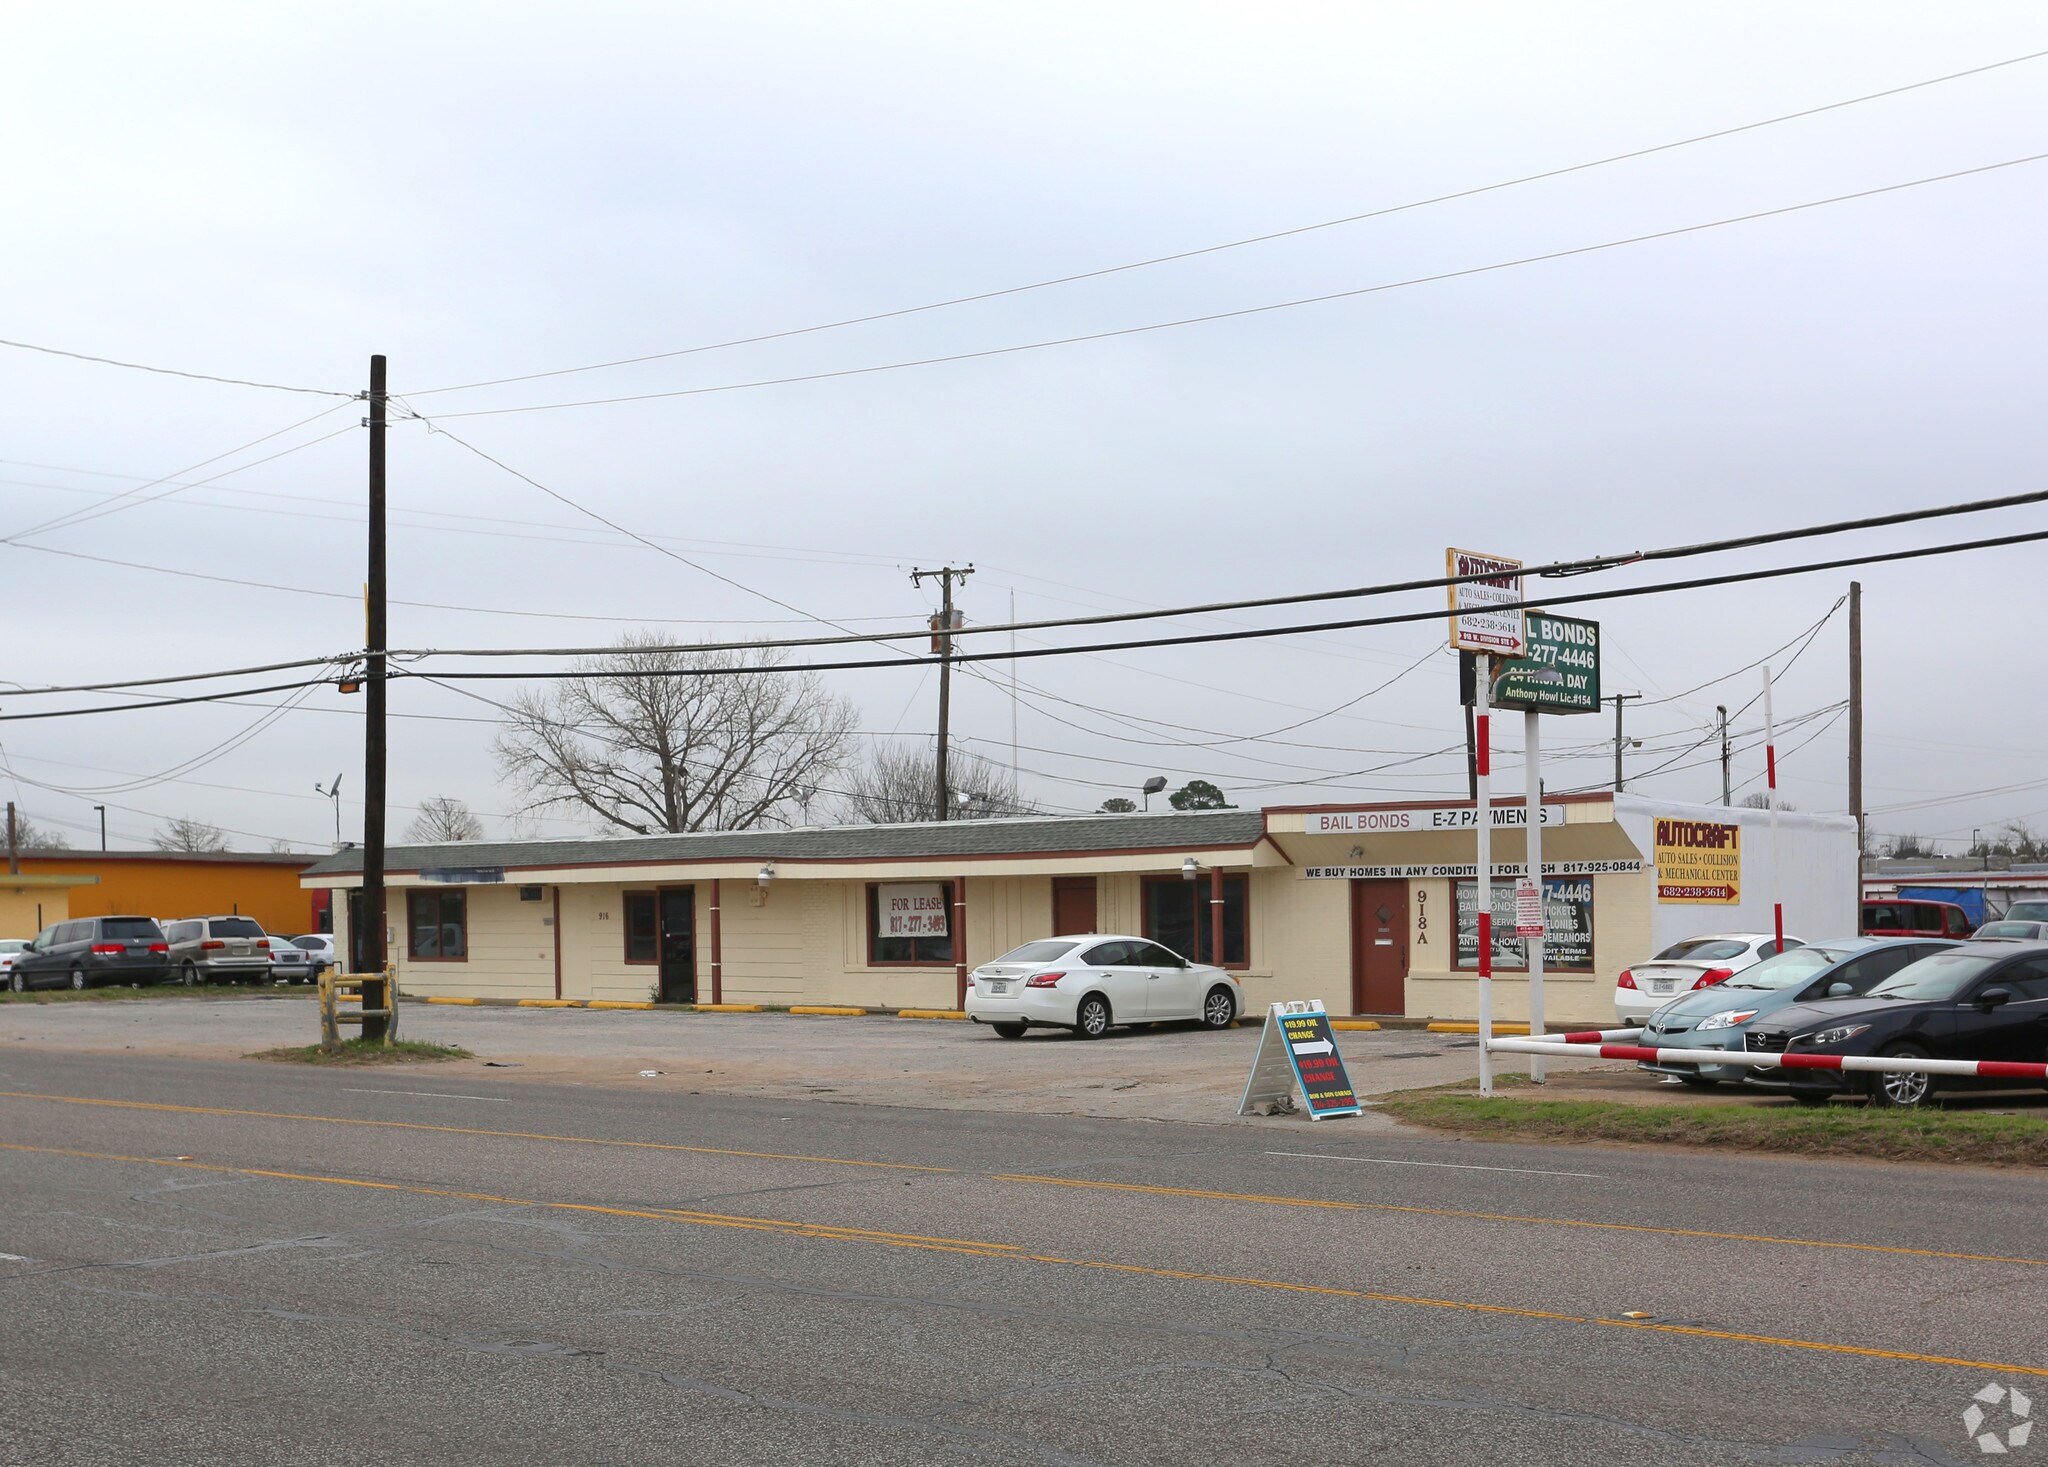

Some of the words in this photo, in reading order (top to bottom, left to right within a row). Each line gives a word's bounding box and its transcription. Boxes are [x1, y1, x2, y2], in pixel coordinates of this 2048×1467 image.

[1459, 587, 1473, 598] AUTO
[1474, 590, 1490, 600] SALES
[1541, 619, 1596, 647] BONDS
[1480, 635, 1500, 645] DIVISION
[1567, 674, 1588, 690] DAY
[1505, 686, 1538, 702] Anthony
[1540, 690, 1558, 702] Howl
[1320, 815, 1353, 830] BAIL
[1357, 813, 1410, 829] BONDS
[1433, 811, 1457, 826] E-Z
[1657, 820, 1738, 849] AUTOCRAFT
[1658, 851, 1676, 864] AUTO
[1677, 852, 1698, 865] SALES
[1703, 853, 1738, 866] COLLISION
[1306, 868, 1321, 877] WE
[1325, 867, 1346, 877] BUY
[1350, 866, 1386, 877] HOMES
[1391, 867, 1402, 876] IN
[1406, 866, 1428, 876] ANY
[1498, 864, 1520, 875] FOR
[1658, 867, 1664, 879] &
[1665, 867, 1711, 881] MECHANICAL
[1712, 869, 1738, 881] CENTER
[891, 898, 909, 911] FOR
[914, 897, 943, 911] LEASE
[1459, 902, 1479, 911] BAIL
[1491, 901, 1516, 911] ONDS
[1544, 905, 1577, 916] TICKETS
[599, 911, 609, 920] 916
[1458, 918, 1467, 926] 24
[1491, 918, 1516, 926] SERVIC
[1499, 937, 1522, 946] HOWL
[1284, 1019, 1306, 1028] $19.99
[1306, 1018, 1318, 1027] OIL
[1288, 1030, 1315, 1040] CHANGE
[1325, 1057, 1340, 1067] OIL
[1303, 1071, 1336, 1083] CHANGE
